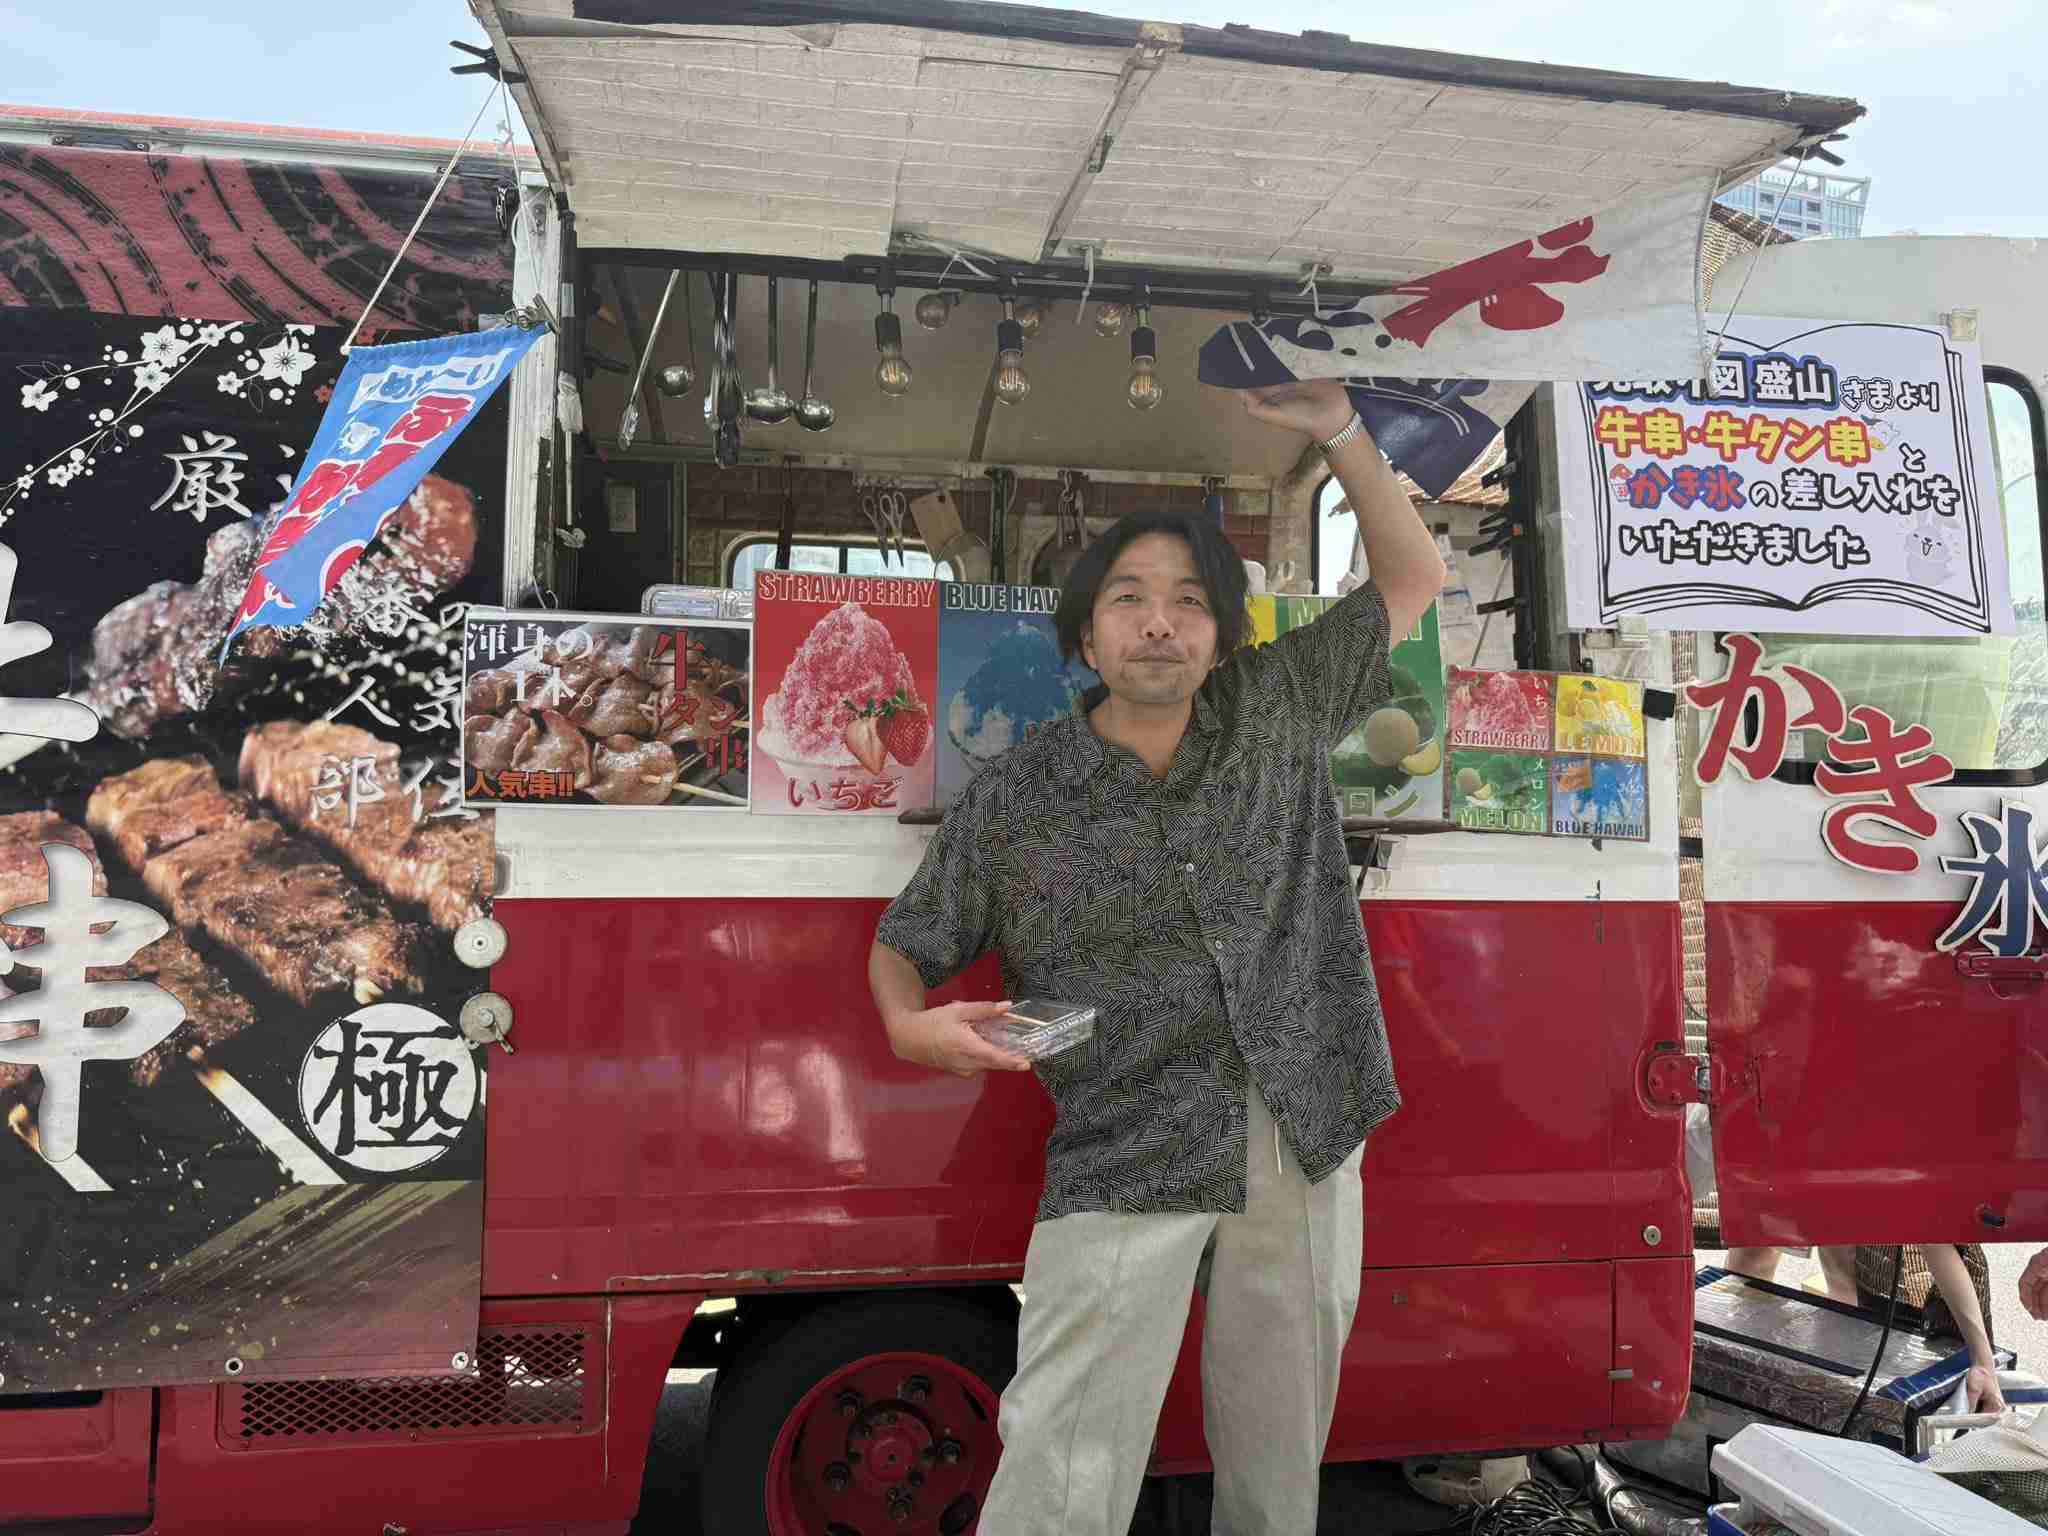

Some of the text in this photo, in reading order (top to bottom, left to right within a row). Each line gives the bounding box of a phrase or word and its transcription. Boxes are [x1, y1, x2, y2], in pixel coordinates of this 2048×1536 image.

[1618, 519, 1871, 568] いただきました
[758, 572, 936, 607] STRAWBERRY
[945, 583, 1008, 612] BLUE
[466, 623, 593, 661] 渾身の
[1454, 730, 1548, 749] STRAWBERRY
[786, 776, 904, 811] いちご
[1686, 633, 2048, 956] かき氷
[1456, 808, 1544, 832] MELON
[1555, 820, 1645, 837] BLUE HAWAII
[312, 1020, 466, 1156] 極
